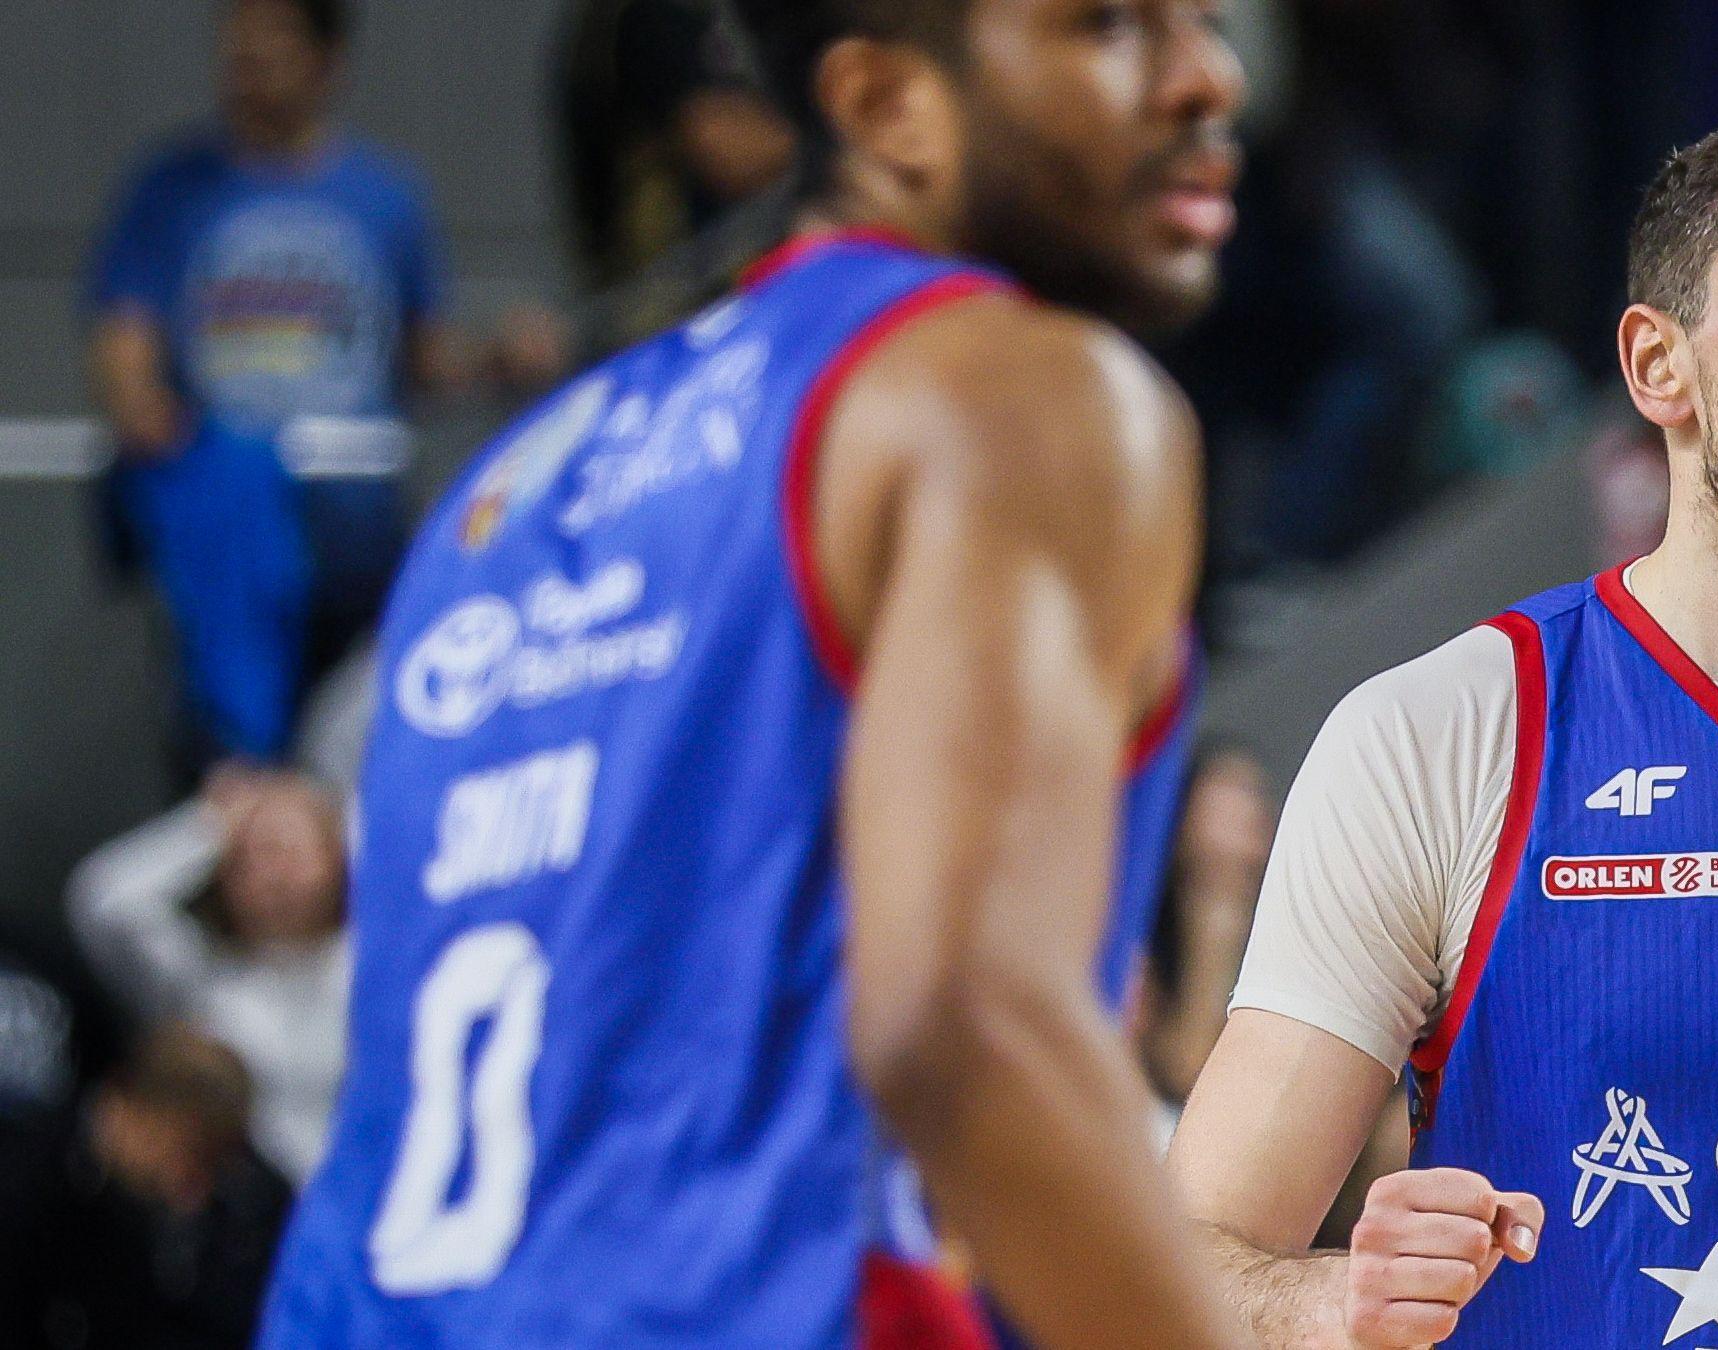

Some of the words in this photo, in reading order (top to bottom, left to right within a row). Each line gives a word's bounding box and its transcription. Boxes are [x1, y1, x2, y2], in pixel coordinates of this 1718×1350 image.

[1585, 765, 1688, 816] 4F
[1554, 865, 1653, 890] ORLEN
[370, 922, 551, 1295] 0
